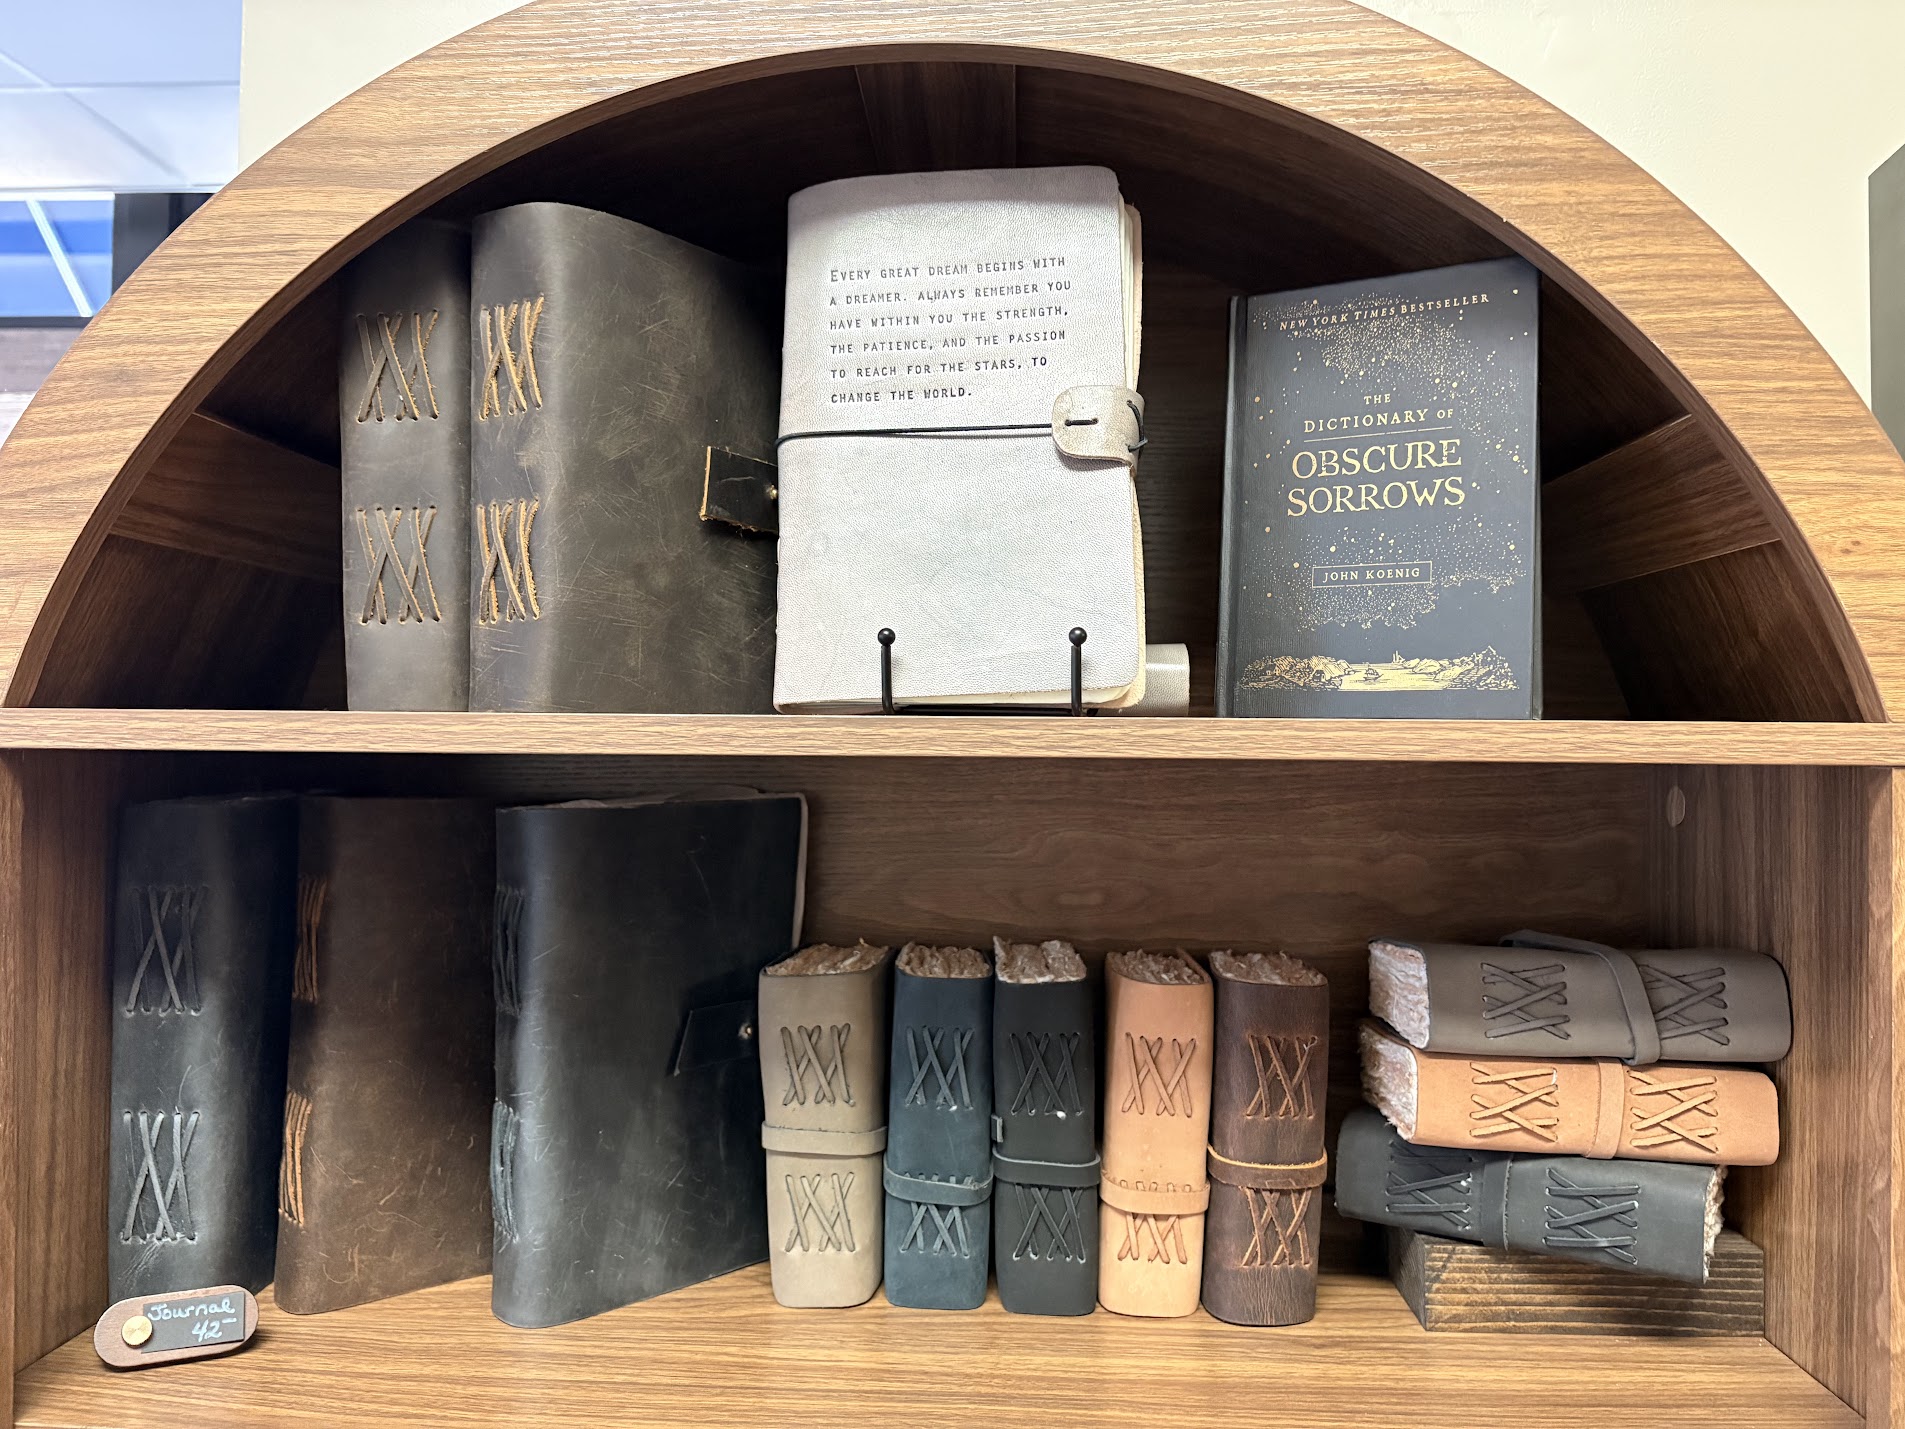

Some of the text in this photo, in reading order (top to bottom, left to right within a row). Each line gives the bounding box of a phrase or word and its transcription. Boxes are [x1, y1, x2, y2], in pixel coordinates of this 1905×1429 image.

[830, 256, 1065, 282] EVERY GREAT DREAM BEGINS WITH
[829, 281, 1071, 306] A DREAMER. ALWAYS REMEMBER YOU
[830, 305, 1069, 330] HAVE WITHIN YOU THE STRENGTH,
[1279, 293, 1489, 331] NEW YORK TIMES BESTSELLER
[831, 330, 1066, 354] THE PATIENCE, AND THE PASSION
[831, 357, 1047, 379] TO REACH FOR THE STARS, TO
[831, 387, 972, 404] CHANGE THE WORLD.
[1364, 394, 1391, 404] THE
[1304, 409, 1453, 433] DICTIONARY OF
[1292, 438, 1462, 479] OBSCURE
[1287, 476, 1466, 517] SORROWS
[1323, 568, 1421, 582] JOHN KOENIG
[148, 1296, 235, 1321] Journal
